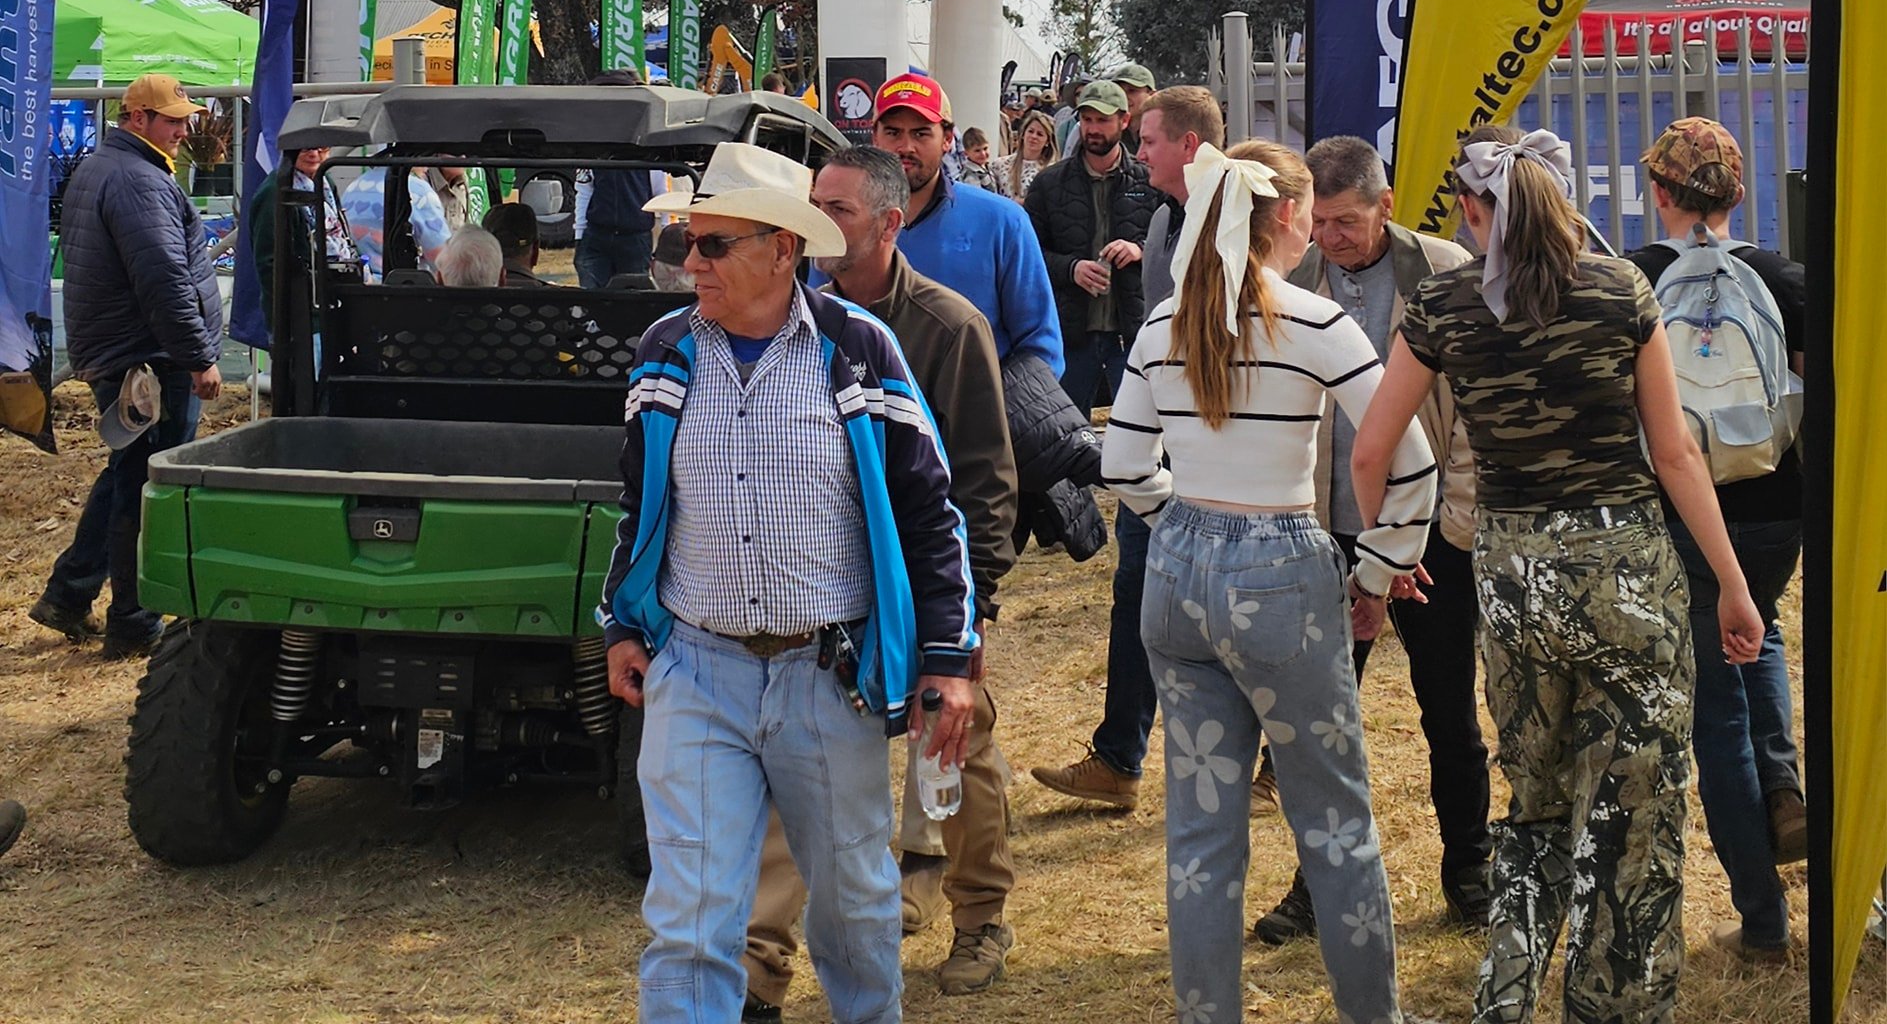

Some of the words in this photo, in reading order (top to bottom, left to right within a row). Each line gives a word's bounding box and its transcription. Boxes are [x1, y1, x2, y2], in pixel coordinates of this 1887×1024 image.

[430, 59, 440, 70] in
[22, 89, 37, 139] best
[22, 147, 33, 182] the
